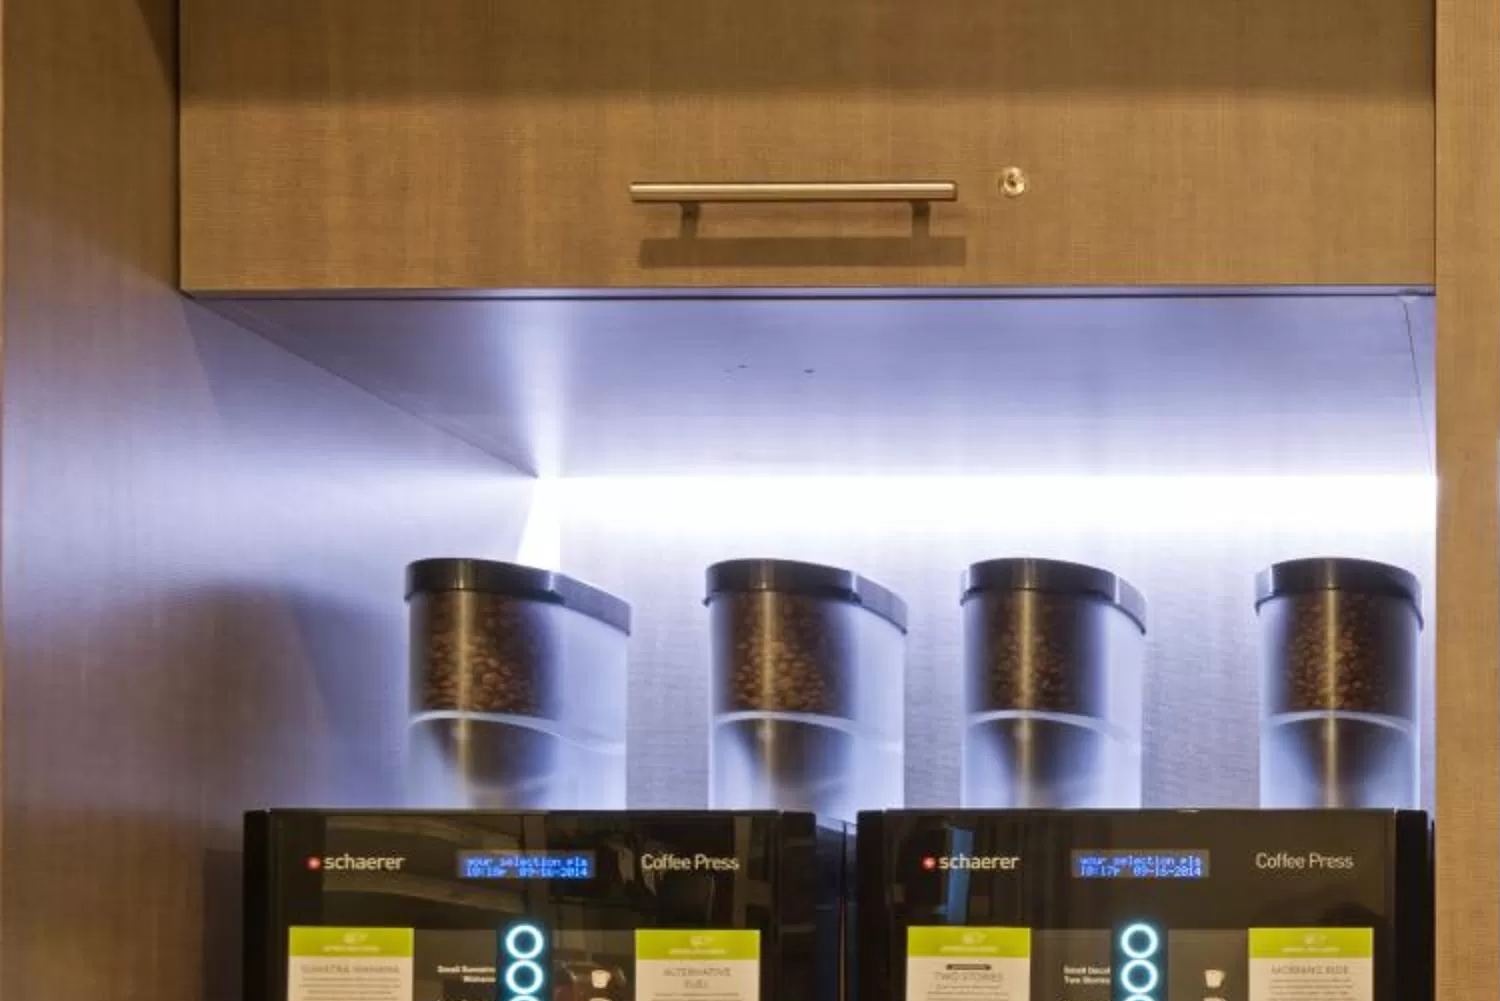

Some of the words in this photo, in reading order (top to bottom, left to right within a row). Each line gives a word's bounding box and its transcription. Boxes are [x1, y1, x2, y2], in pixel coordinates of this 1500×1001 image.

[323, 853, 406, 870] schaerer
[641, 853, 692, 870] Coffee
[695, 853, 741, 870] Press
[938, 852, 1020, 870] schaerer
[1256, 852, 1304, 869] Coffee
[1309, 852, 1355, 869] Press
